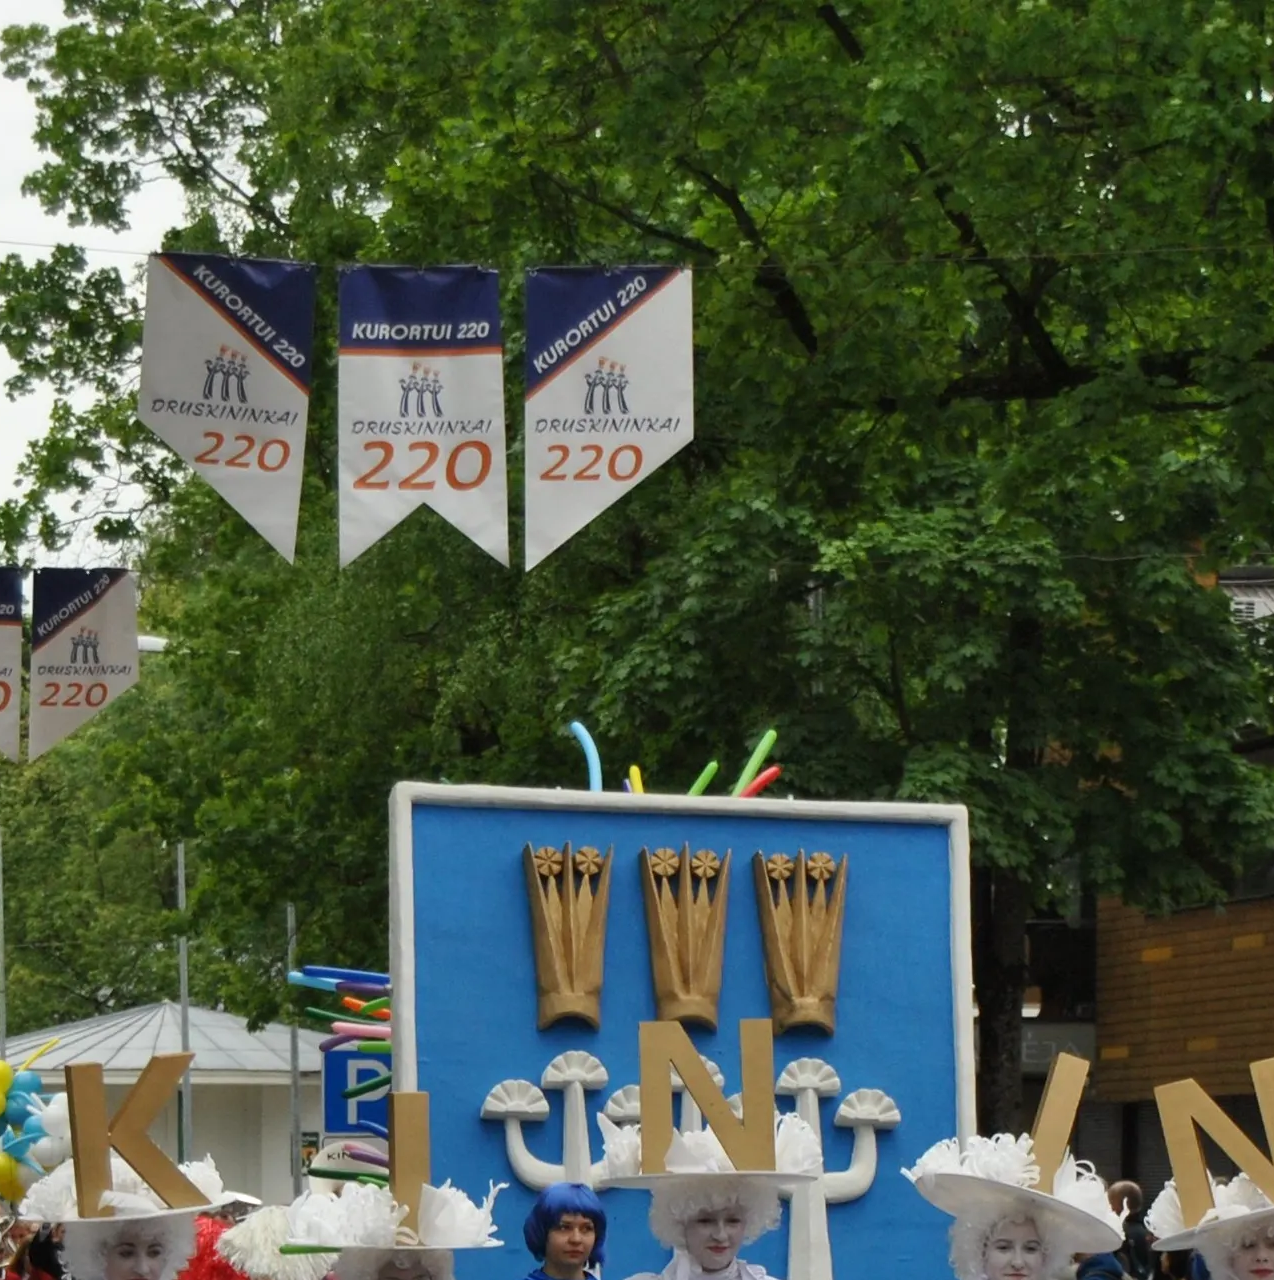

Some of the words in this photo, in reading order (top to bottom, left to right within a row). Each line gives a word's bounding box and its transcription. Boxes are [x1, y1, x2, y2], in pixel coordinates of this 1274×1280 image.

[191, 263, 277, 344] KURORTUI
[271, 335, 307, 370] 220
[350, 323, 452, 342] KURORTUI
[455, 321, 491, 340] 220
[532, 299, 618, 373] KURORTUI
[615, 274, 648, 308] 220
[150, 397, 300, 427] DRUSKININKAI
[351, 417, 494, 437] DRUSKININKAI
[534, 415, 681, 435] DRUSKININKAI
[193, 430, 292, 473] 220
[351, 439, 494, 492] 220
[538, 443, 645, 482] 220
[36, 590, 94, 638] KURORTUI
[92, 573, 112, 596] 220
[36, 664, 132, 677] DRUSKININKAI
[39, 681, 109, 708] 220
